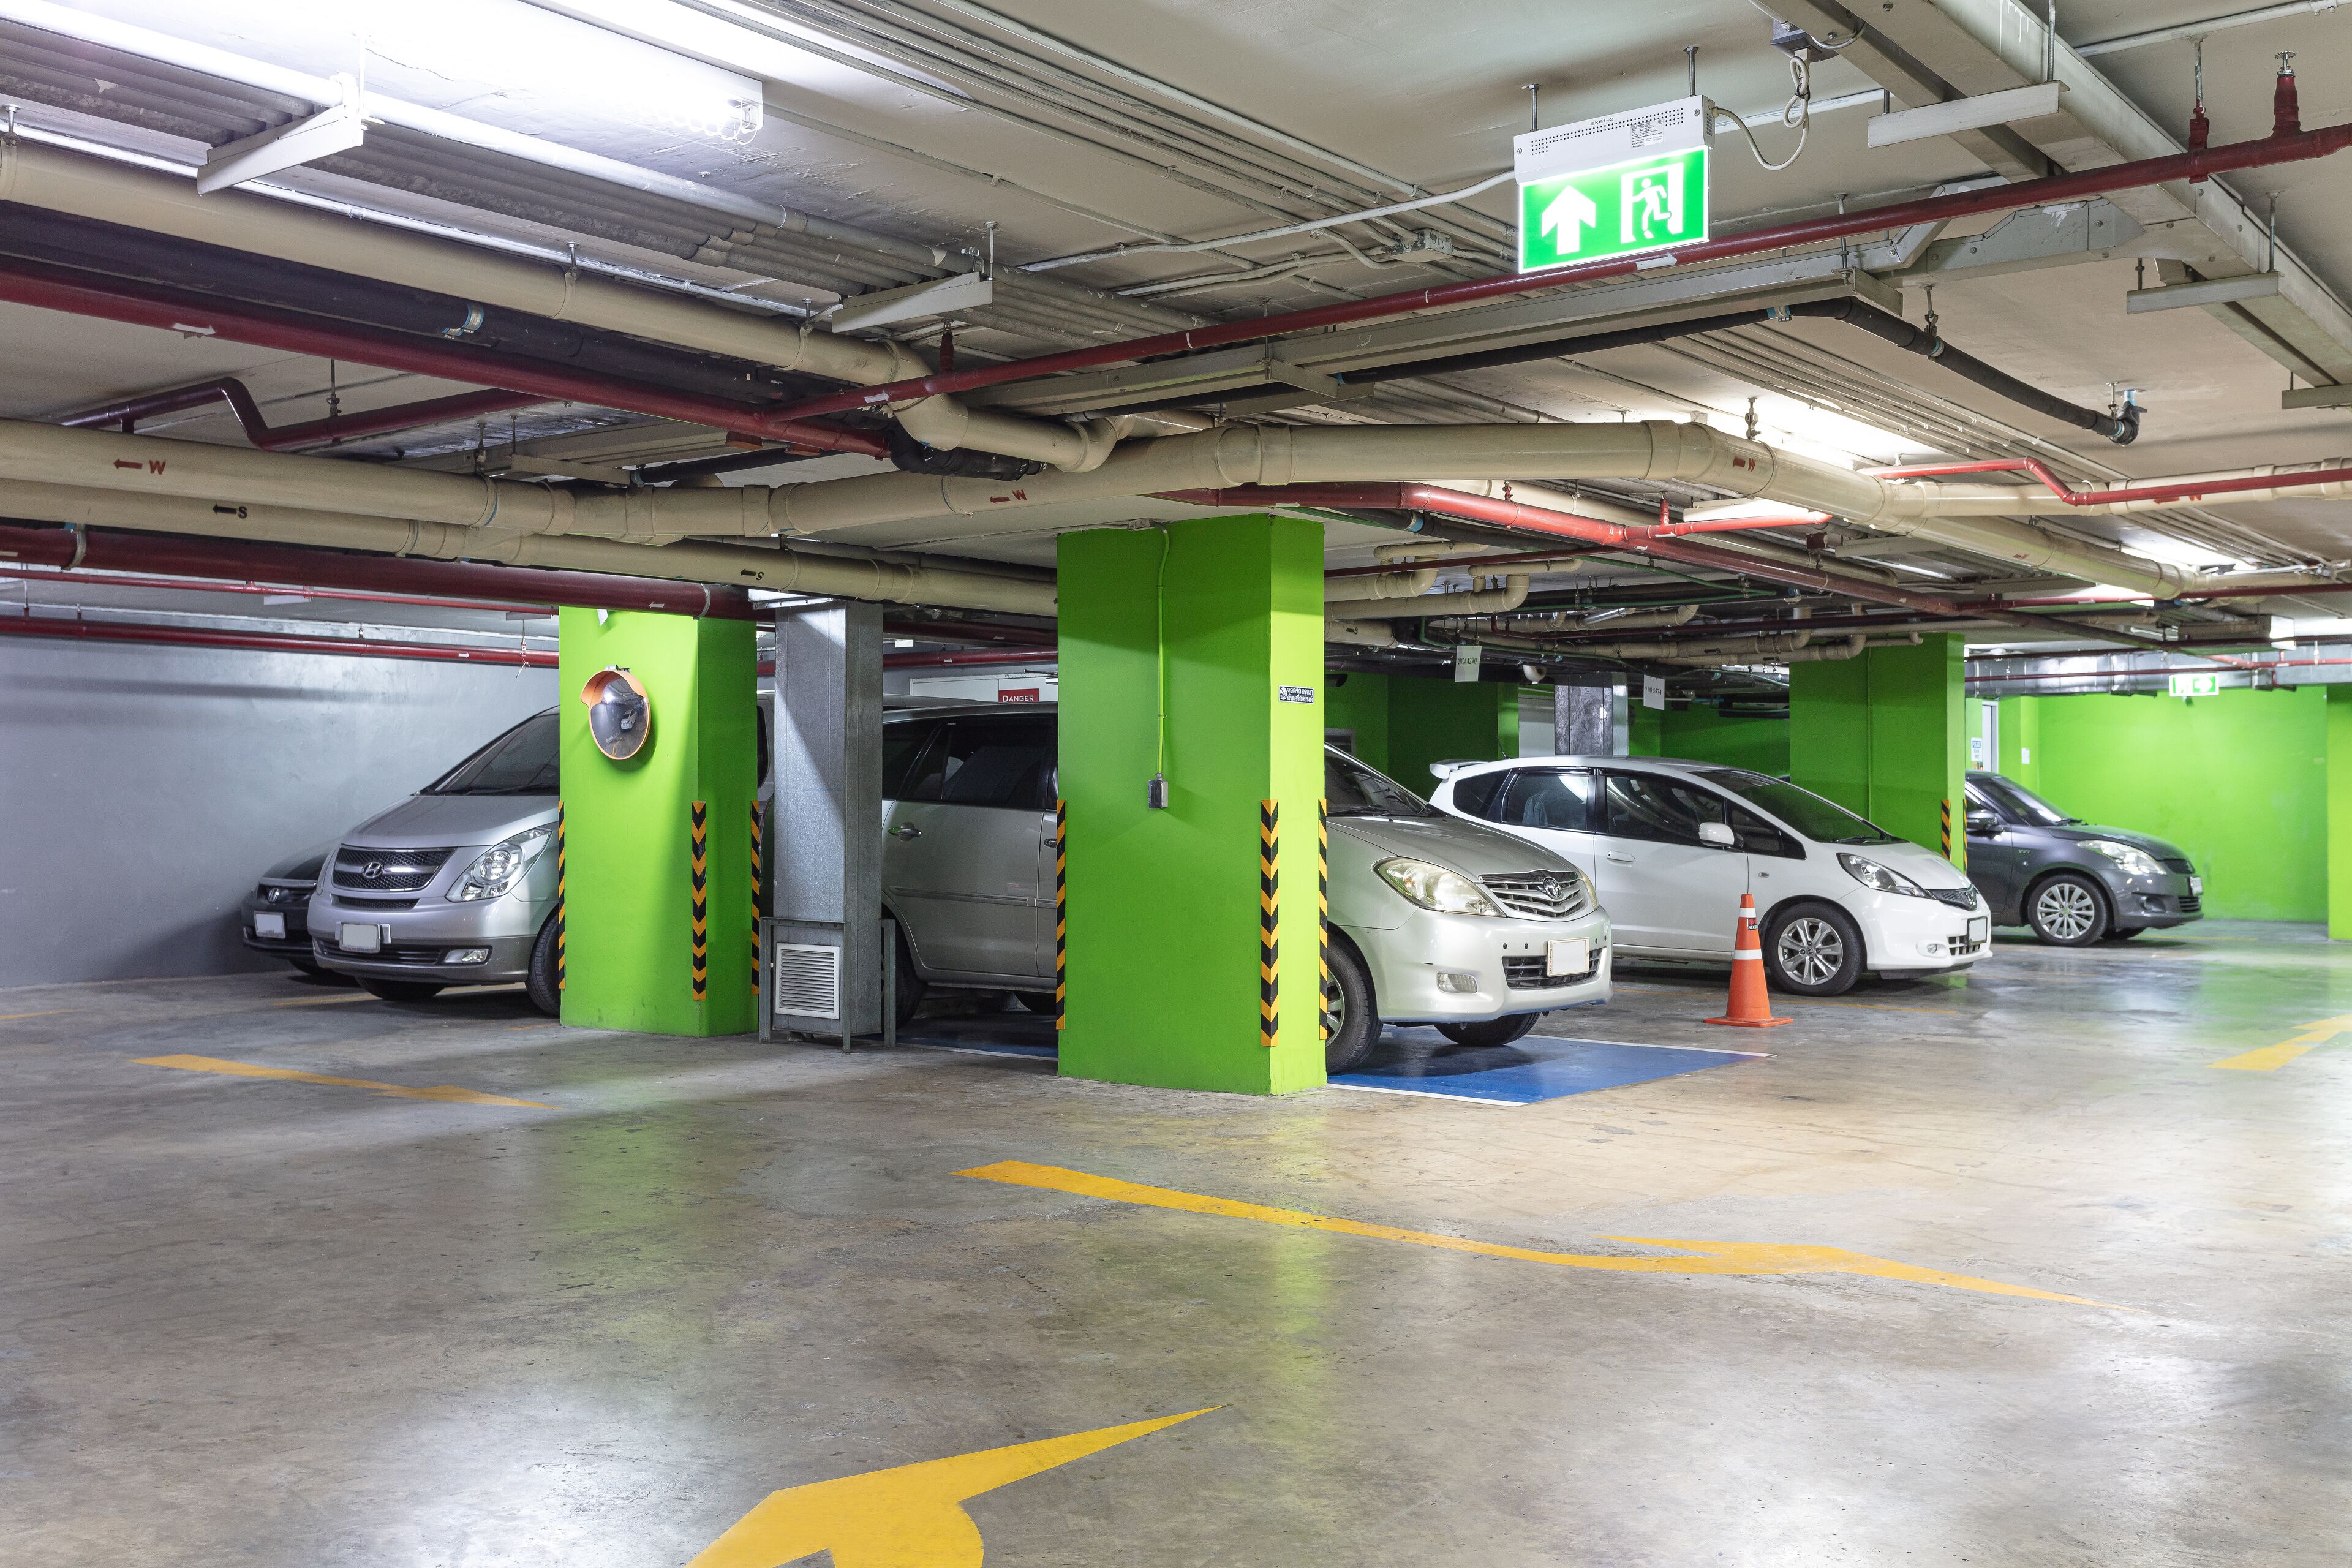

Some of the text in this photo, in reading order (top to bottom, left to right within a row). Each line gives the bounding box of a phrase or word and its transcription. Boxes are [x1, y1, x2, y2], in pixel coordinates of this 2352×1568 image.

[1590, 117, 1614, 126] EXB1-2
[149, 460, 166, 475] W
[1011, 489, 1027, 500] W
[238, 505, 248, 519] S
[756, 571, 764, 581] S
[1653, 687, 1662, 695] 5574
